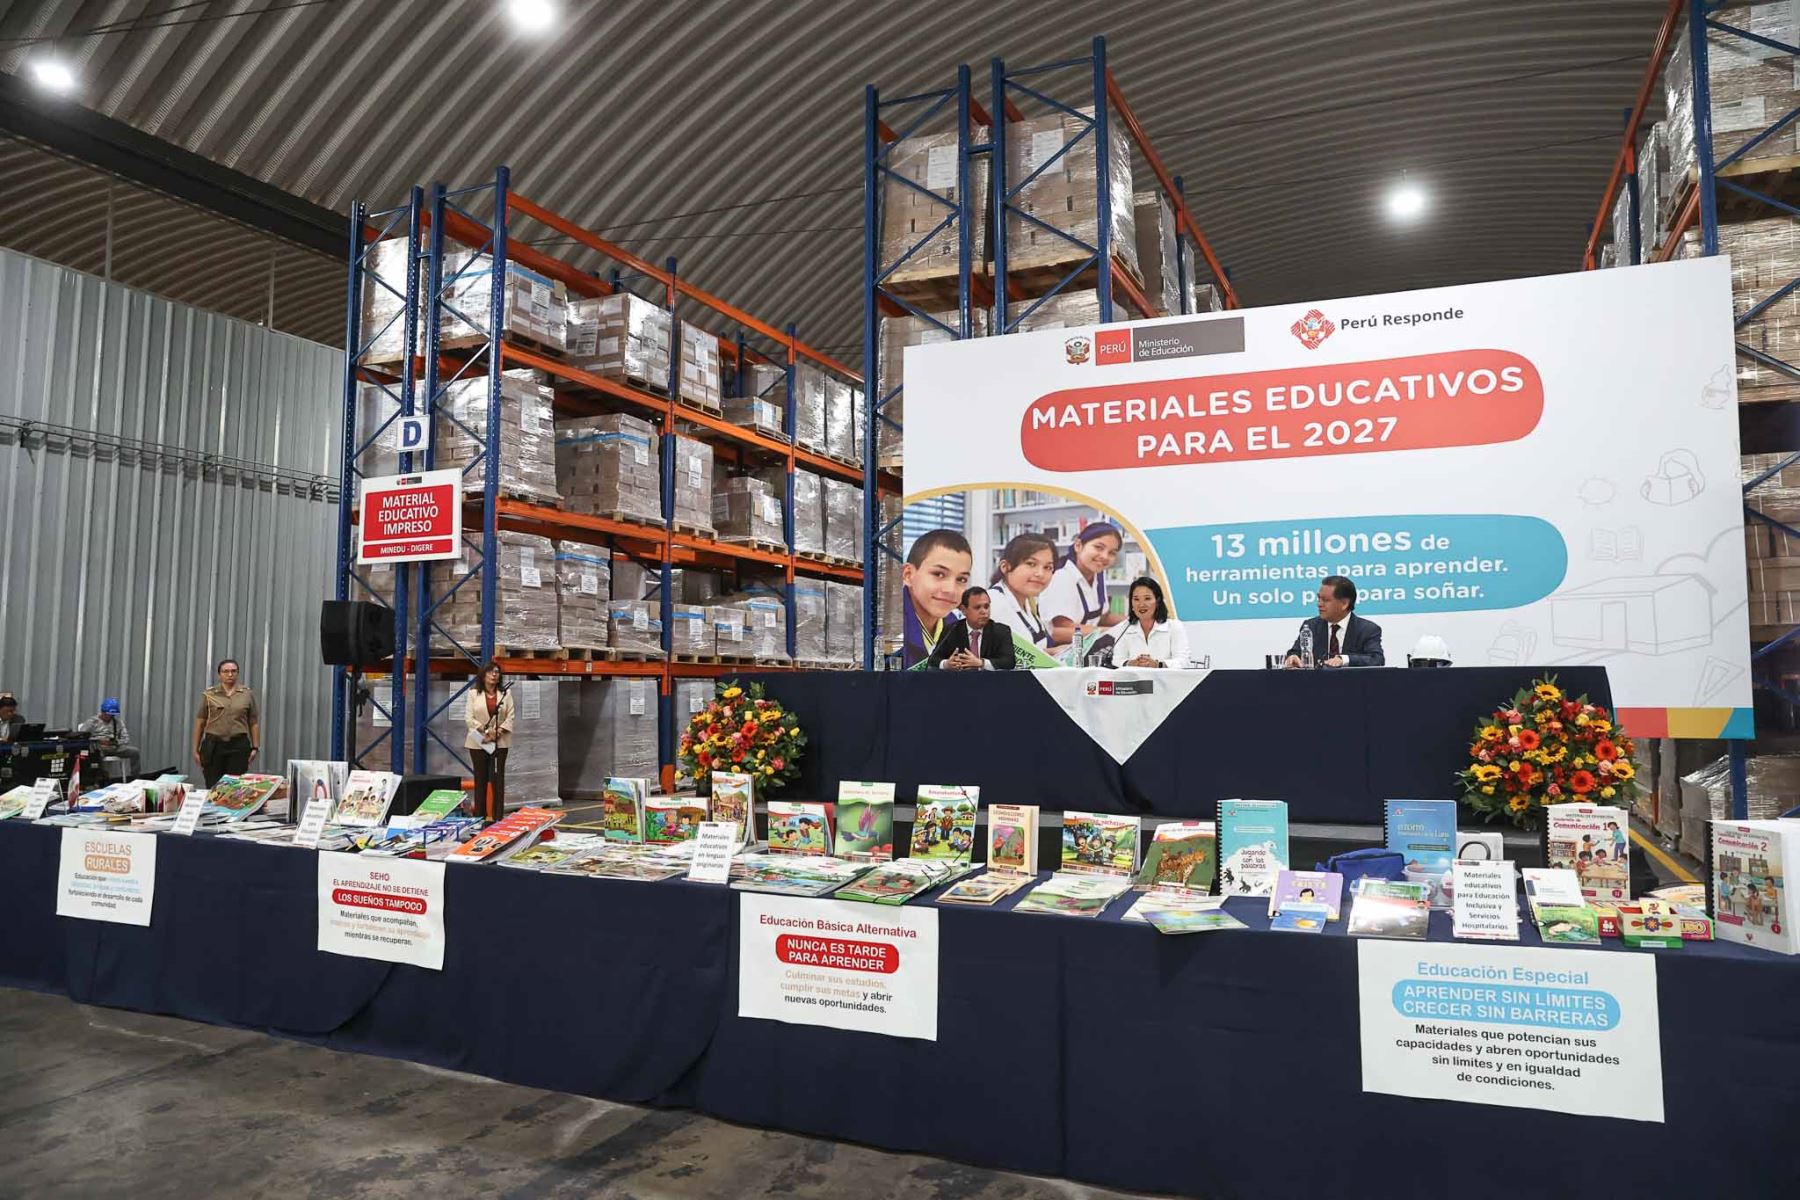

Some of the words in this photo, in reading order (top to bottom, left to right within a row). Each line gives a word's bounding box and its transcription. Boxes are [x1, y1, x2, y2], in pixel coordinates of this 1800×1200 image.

[1341, 316, 1378, 330] Perú
[1383, 308, 1464, 326] Responde
[1100, 340, 1126, 354] PERÚ
[1138, 337, 1180, 348] Ministerio
[1139, 348, 1150, 357] de
[1152, 344, 1194, 356] Educación
[1032, 390, 1252, 430] MATERIALES
[1266, 366, 1524, 411] EDUCATIVOS
[403, 421, 422, 447] D
[1137, 429, 1233, 459] PARA
[1246, 425, 1290, 451] EL
[1303, 416, 1398, 447] 2027
[382, 492, 435, 508] MATERIAL
[378, 506, 438, 522] EDUCATIVO
[384, 520, 432, 536] IMPRESO
[380, 546, 406, 554] MINEDU
[411, 544, 433, 552] DIGERE
[1210, 533, 1246, 559] 13
[1259, 529, 1412, 557] millones
[1420, 534, 1450, 550] de
[1186, 564, 1329, 583] herramientas
[1336, 564, 1387, 578] para
[1395, 556, 1508, 578] aprender.
[1213, 590, 1241, 606] Un
[1249, 588, 1294, 605] solo
[1356, 587, 1406, 604] para
[1414, 582, 1484, 600] soñar.
[1554, 822, 1600, 830] Comunicación
[85, 841, 132, 856] ESCUELAS
[1760, 842, 1767, 852] 2
[86, 858, 128, 872] RURALES
[370, 872, 390, 881] SEHO
[333, 878, 340, 886] EL
[341, 880, 380, 891] APRENDIZAJE
[382, 884, 392, 892] NO
[402, 887, 429, 896] DETIENE
[1474, 892, 1510, 900] Educación
[338, 893, 352, 902] LOS
[353, 894, 384, 906] SUEÑOS
[384, 898, 422, 912] TAMPOCO
[340, 910, 370, 920] Materiales
[370, 914, 382, 922] que
[760, 914, 814, 929] Educación
[817, 920, 854, 932] Básica
[856, 923, 917, 938] Alternativa
[1462, 922, 1508, 930] Hospitalarios
[344, 931, 372, 940] mientras
[787, 938, 828, 952] NUNCA
[830, 943, 845, 954] ES
[847, 944, 886, 958] TARDE
[788, 952, 818, 964] PARA
[821, 955, 884, 970] APRENDER
[786, 970, 826, 982] Culminar
[828, 976, 843, 984] sus
[1418, 962, 1507, 980] Educación
[1513, 968, 1588, 985] Especial
[780, 982, 814, 994] cumplir
[816, 985, 832, 994] sus
[834, 987, 860, 998] metas
[862, 992, 868, 1000] y
[870, 992, 893, 1002] abrir
[1404, 985, 1497, 1002] APRENDER
[1502, 990, 1530, 1004] SIN
[784, 994, 817, 1006] nuevas
[818, 998, 887, 1014] oportunidades.
[1403, 1000, 1472, 1016] CRECER
[1476, 1005, 1505, 1018] SIN
[1510, 1007, 1609, 1026] BARRERAS
[1416, 1024, 1478, 1038] Materiales
[1481, 1030, 1504, 1040] que
[1508, 1032, 1570, 1046] potencian
[1574, 1038, 1597, 1048] sus
[1396, 1039, 1472, 1052] capacidades
[1476, 1046, 1482, 1055] y
[1486, 1045, 1522, 1056] abren
[1525, 1049, 1620, 1065] oportunidades
[1432, 1055, 1450, 1065] sin
[1496, 1062, 1502, 1072] y
[1506, 1063, 1522, 1072] en
[1525, 1062, 1580, 1078] igualdad
[1456, 1072, 1472, 1082] de
[1476, 1075, 1555, 1090] condiciones.
